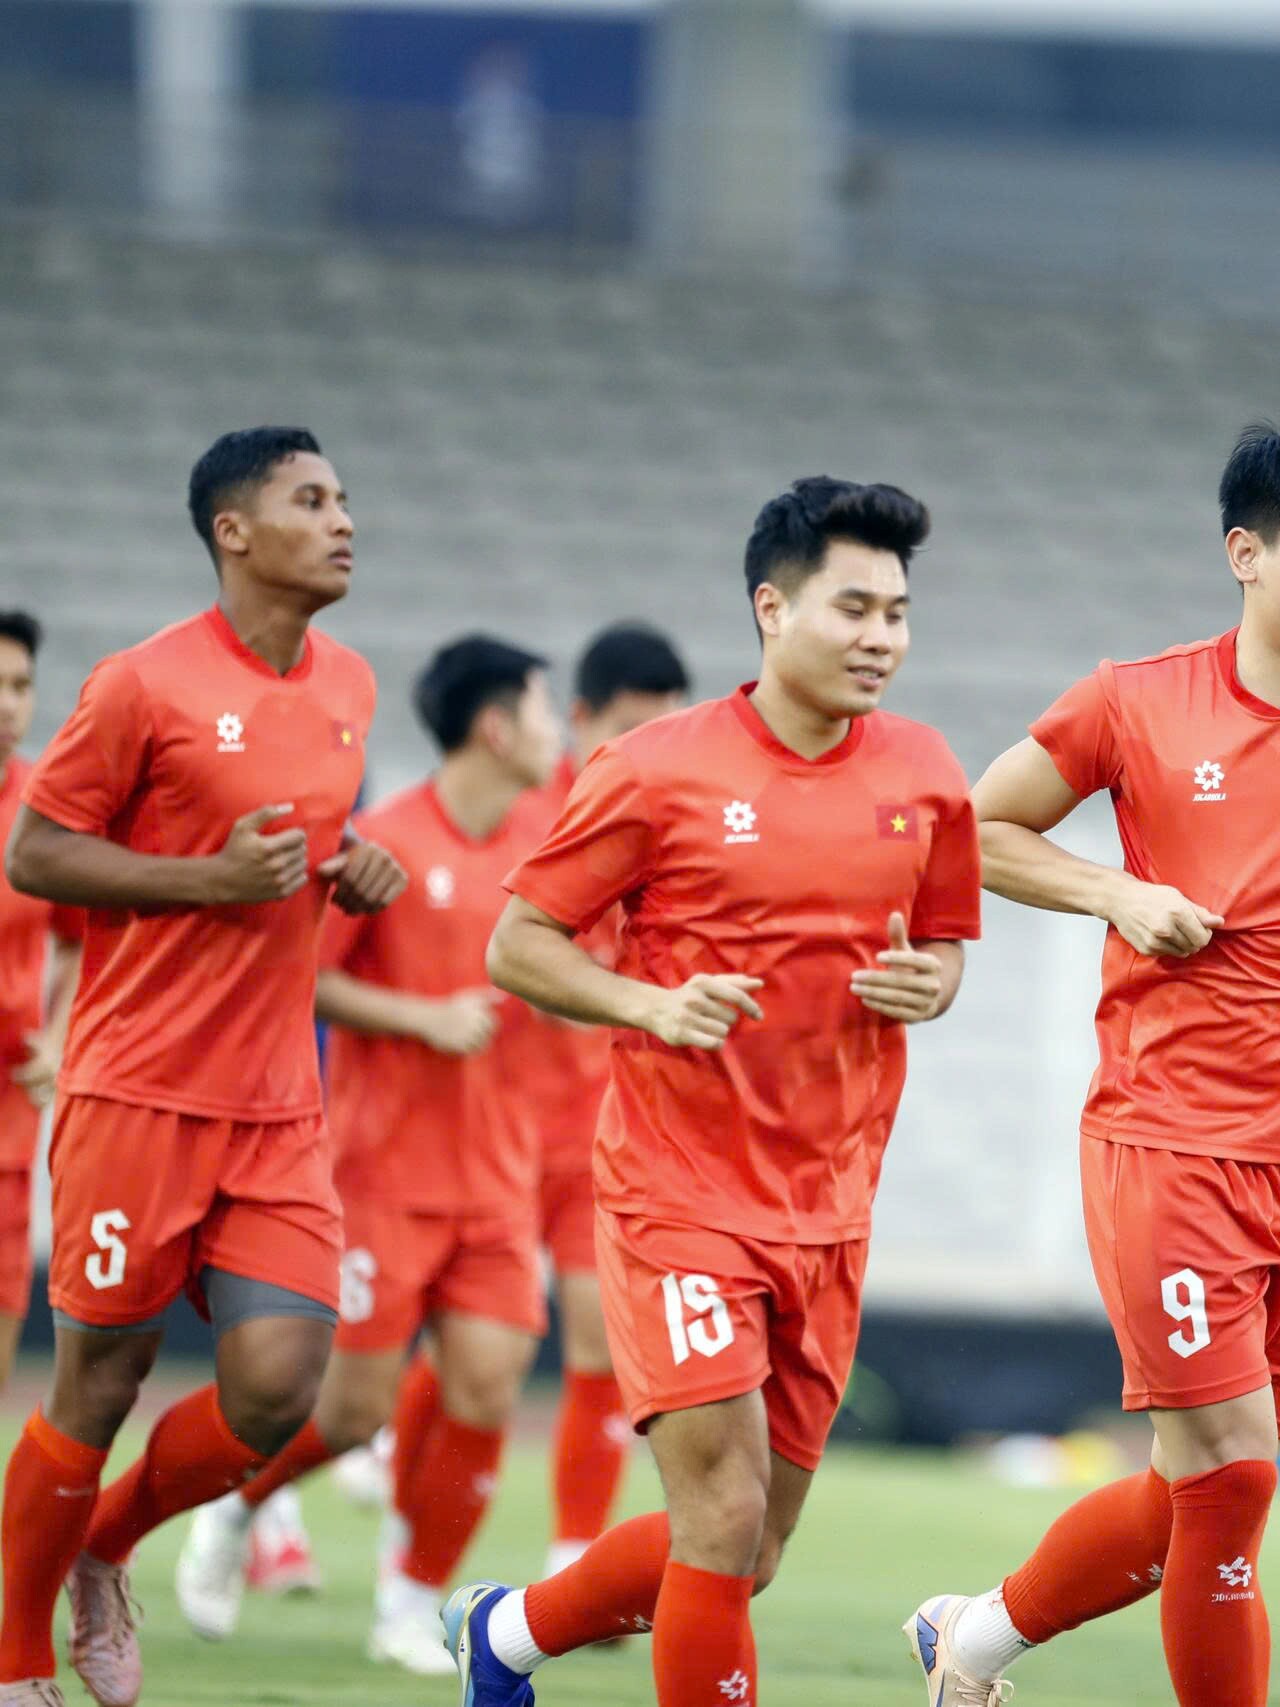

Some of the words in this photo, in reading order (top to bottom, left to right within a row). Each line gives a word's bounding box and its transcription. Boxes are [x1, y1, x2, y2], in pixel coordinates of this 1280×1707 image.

[84, 1208, 132, 1290] 5
[660, 1271, 734, 1366] 15
[1160, 1267, 1212, 1358] 9
